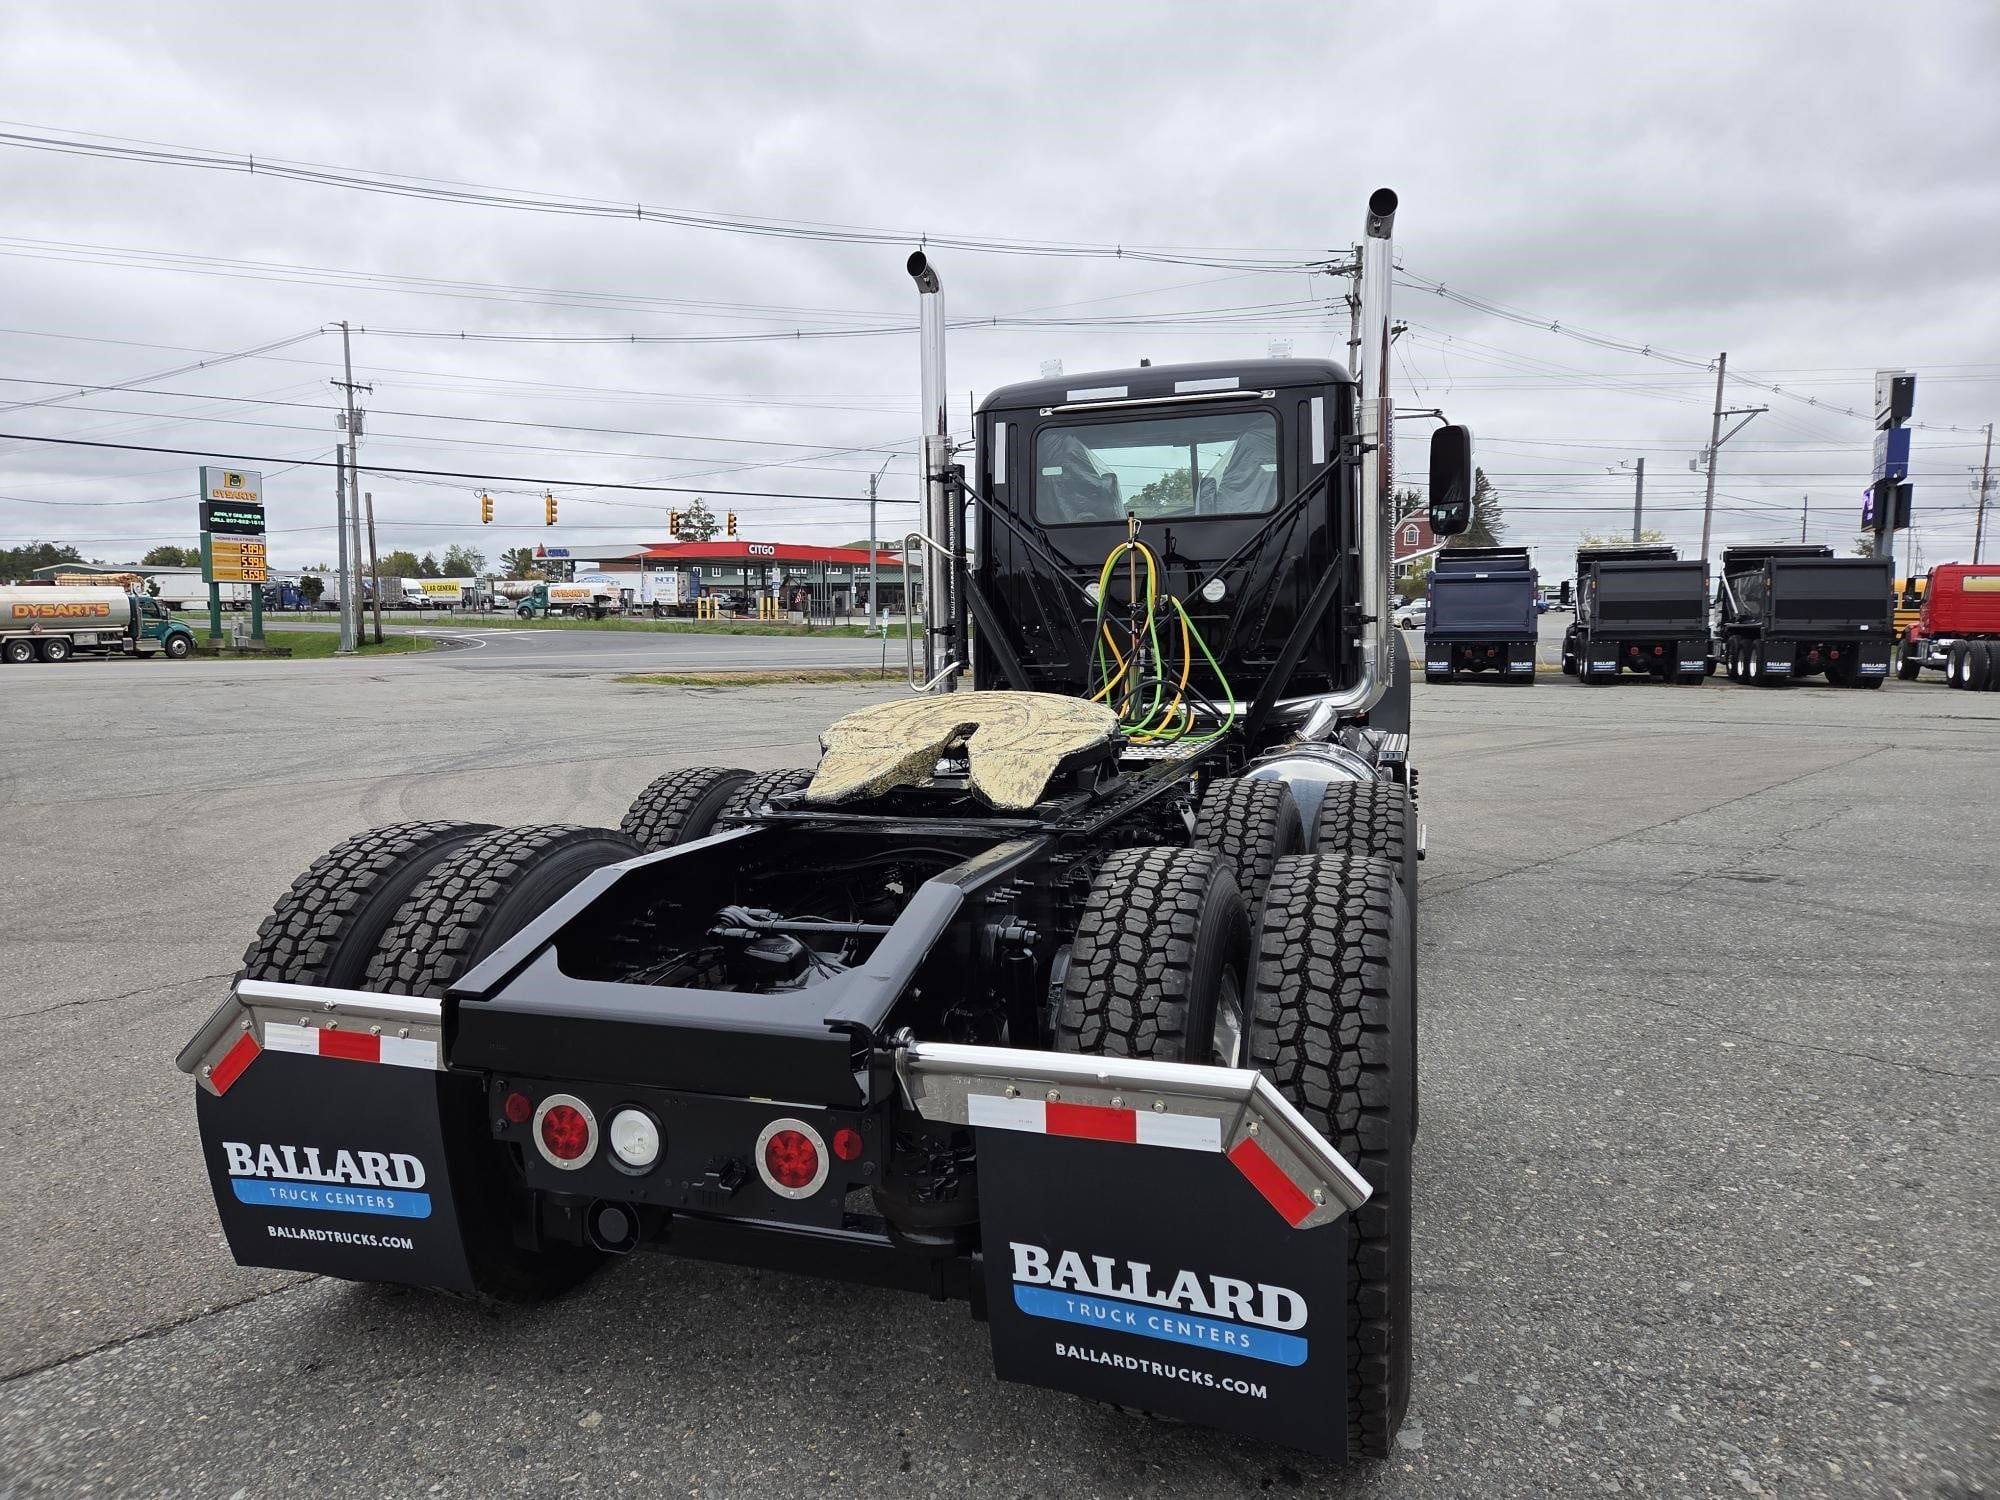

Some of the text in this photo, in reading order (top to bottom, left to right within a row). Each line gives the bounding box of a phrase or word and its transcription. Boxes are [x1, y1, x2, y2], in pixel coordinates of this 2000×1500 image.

[749, 544, 775, 556] CITGO
[436, 584, 457, 592] GENERAL
[222, 1141, 426, 1189] BALLARD
[270, 1187, 395, 1209] TRUCK CENTERS
[268, 1225, 414, 1250] BALLARDTRUCKS.COM
[1009, 1241, 1309, 1331] BALLARD
[1066, 1300, 1251, 1348] TRUCK CENTERS
[1055, 1342, 1268, 1400] BALLARDTRUCKS.COM
